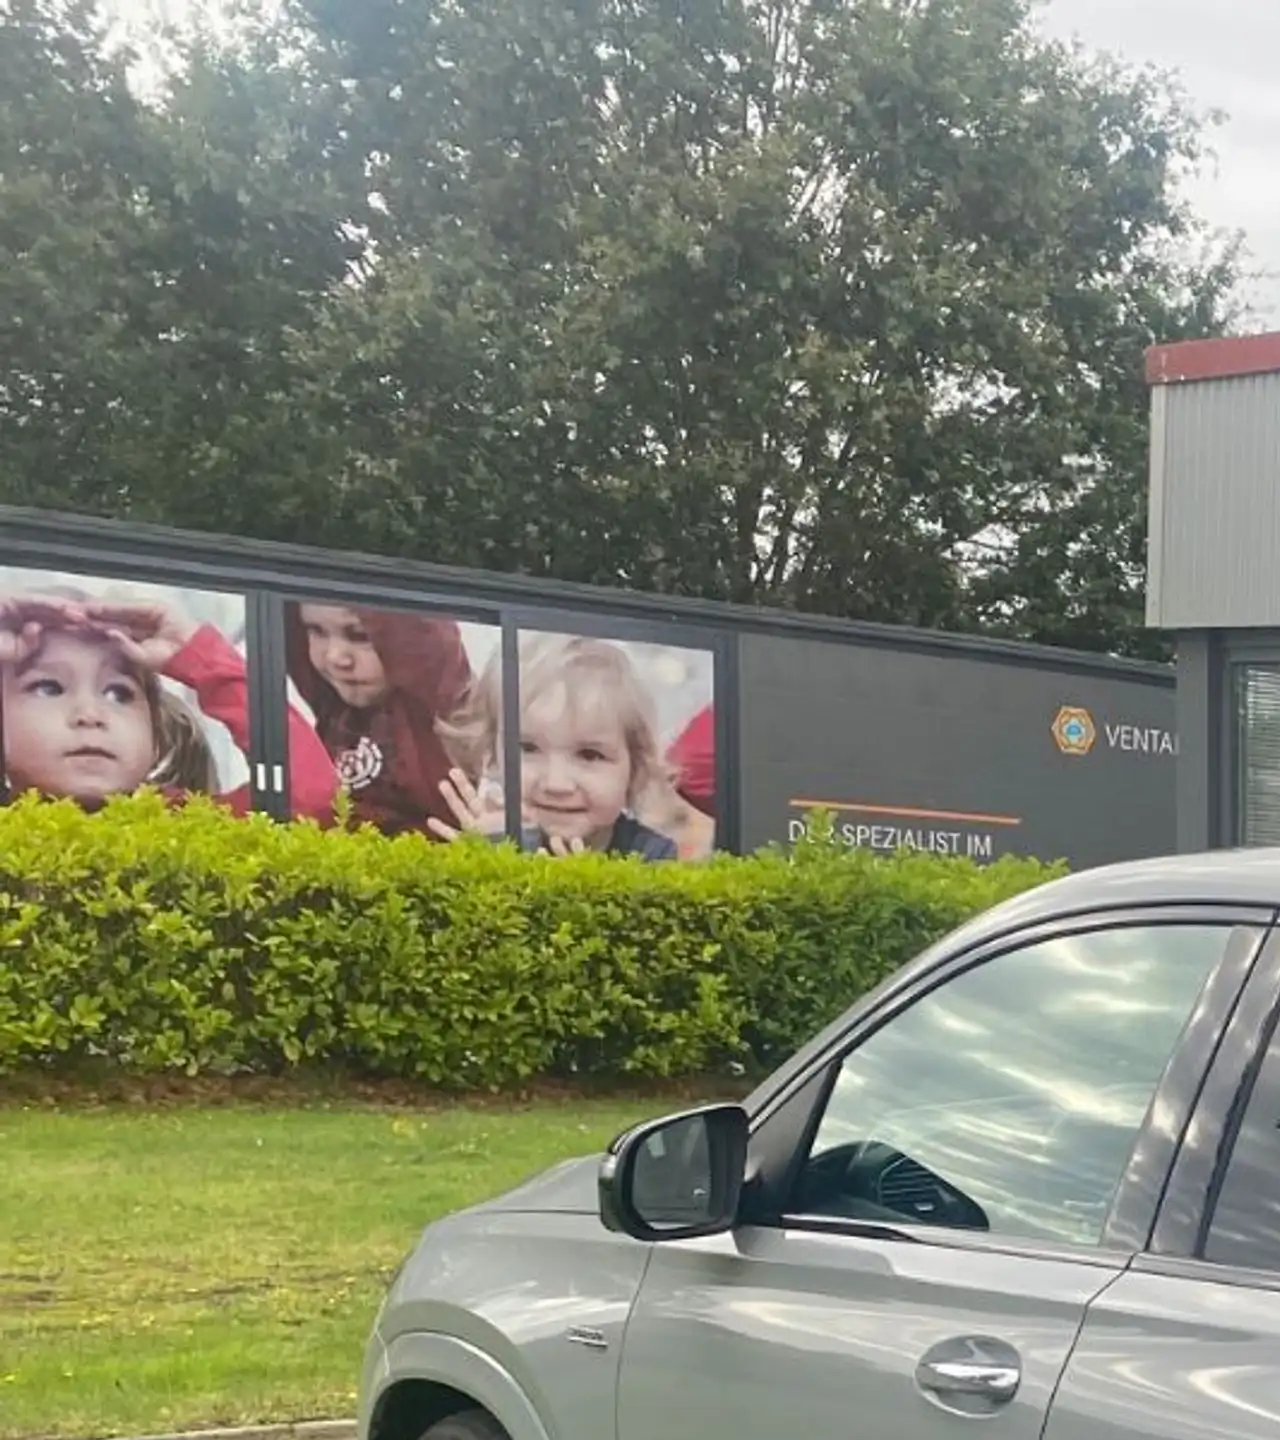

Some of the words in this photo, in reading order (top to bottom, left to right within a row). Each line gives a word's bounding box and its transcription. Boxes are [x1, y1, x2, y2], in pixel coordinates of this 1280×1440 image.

[1104, 723, 1180, 756] VENTA
[842, 823, 961, 854] SPEZIALIST
[966, 833, 992, 857] IM
